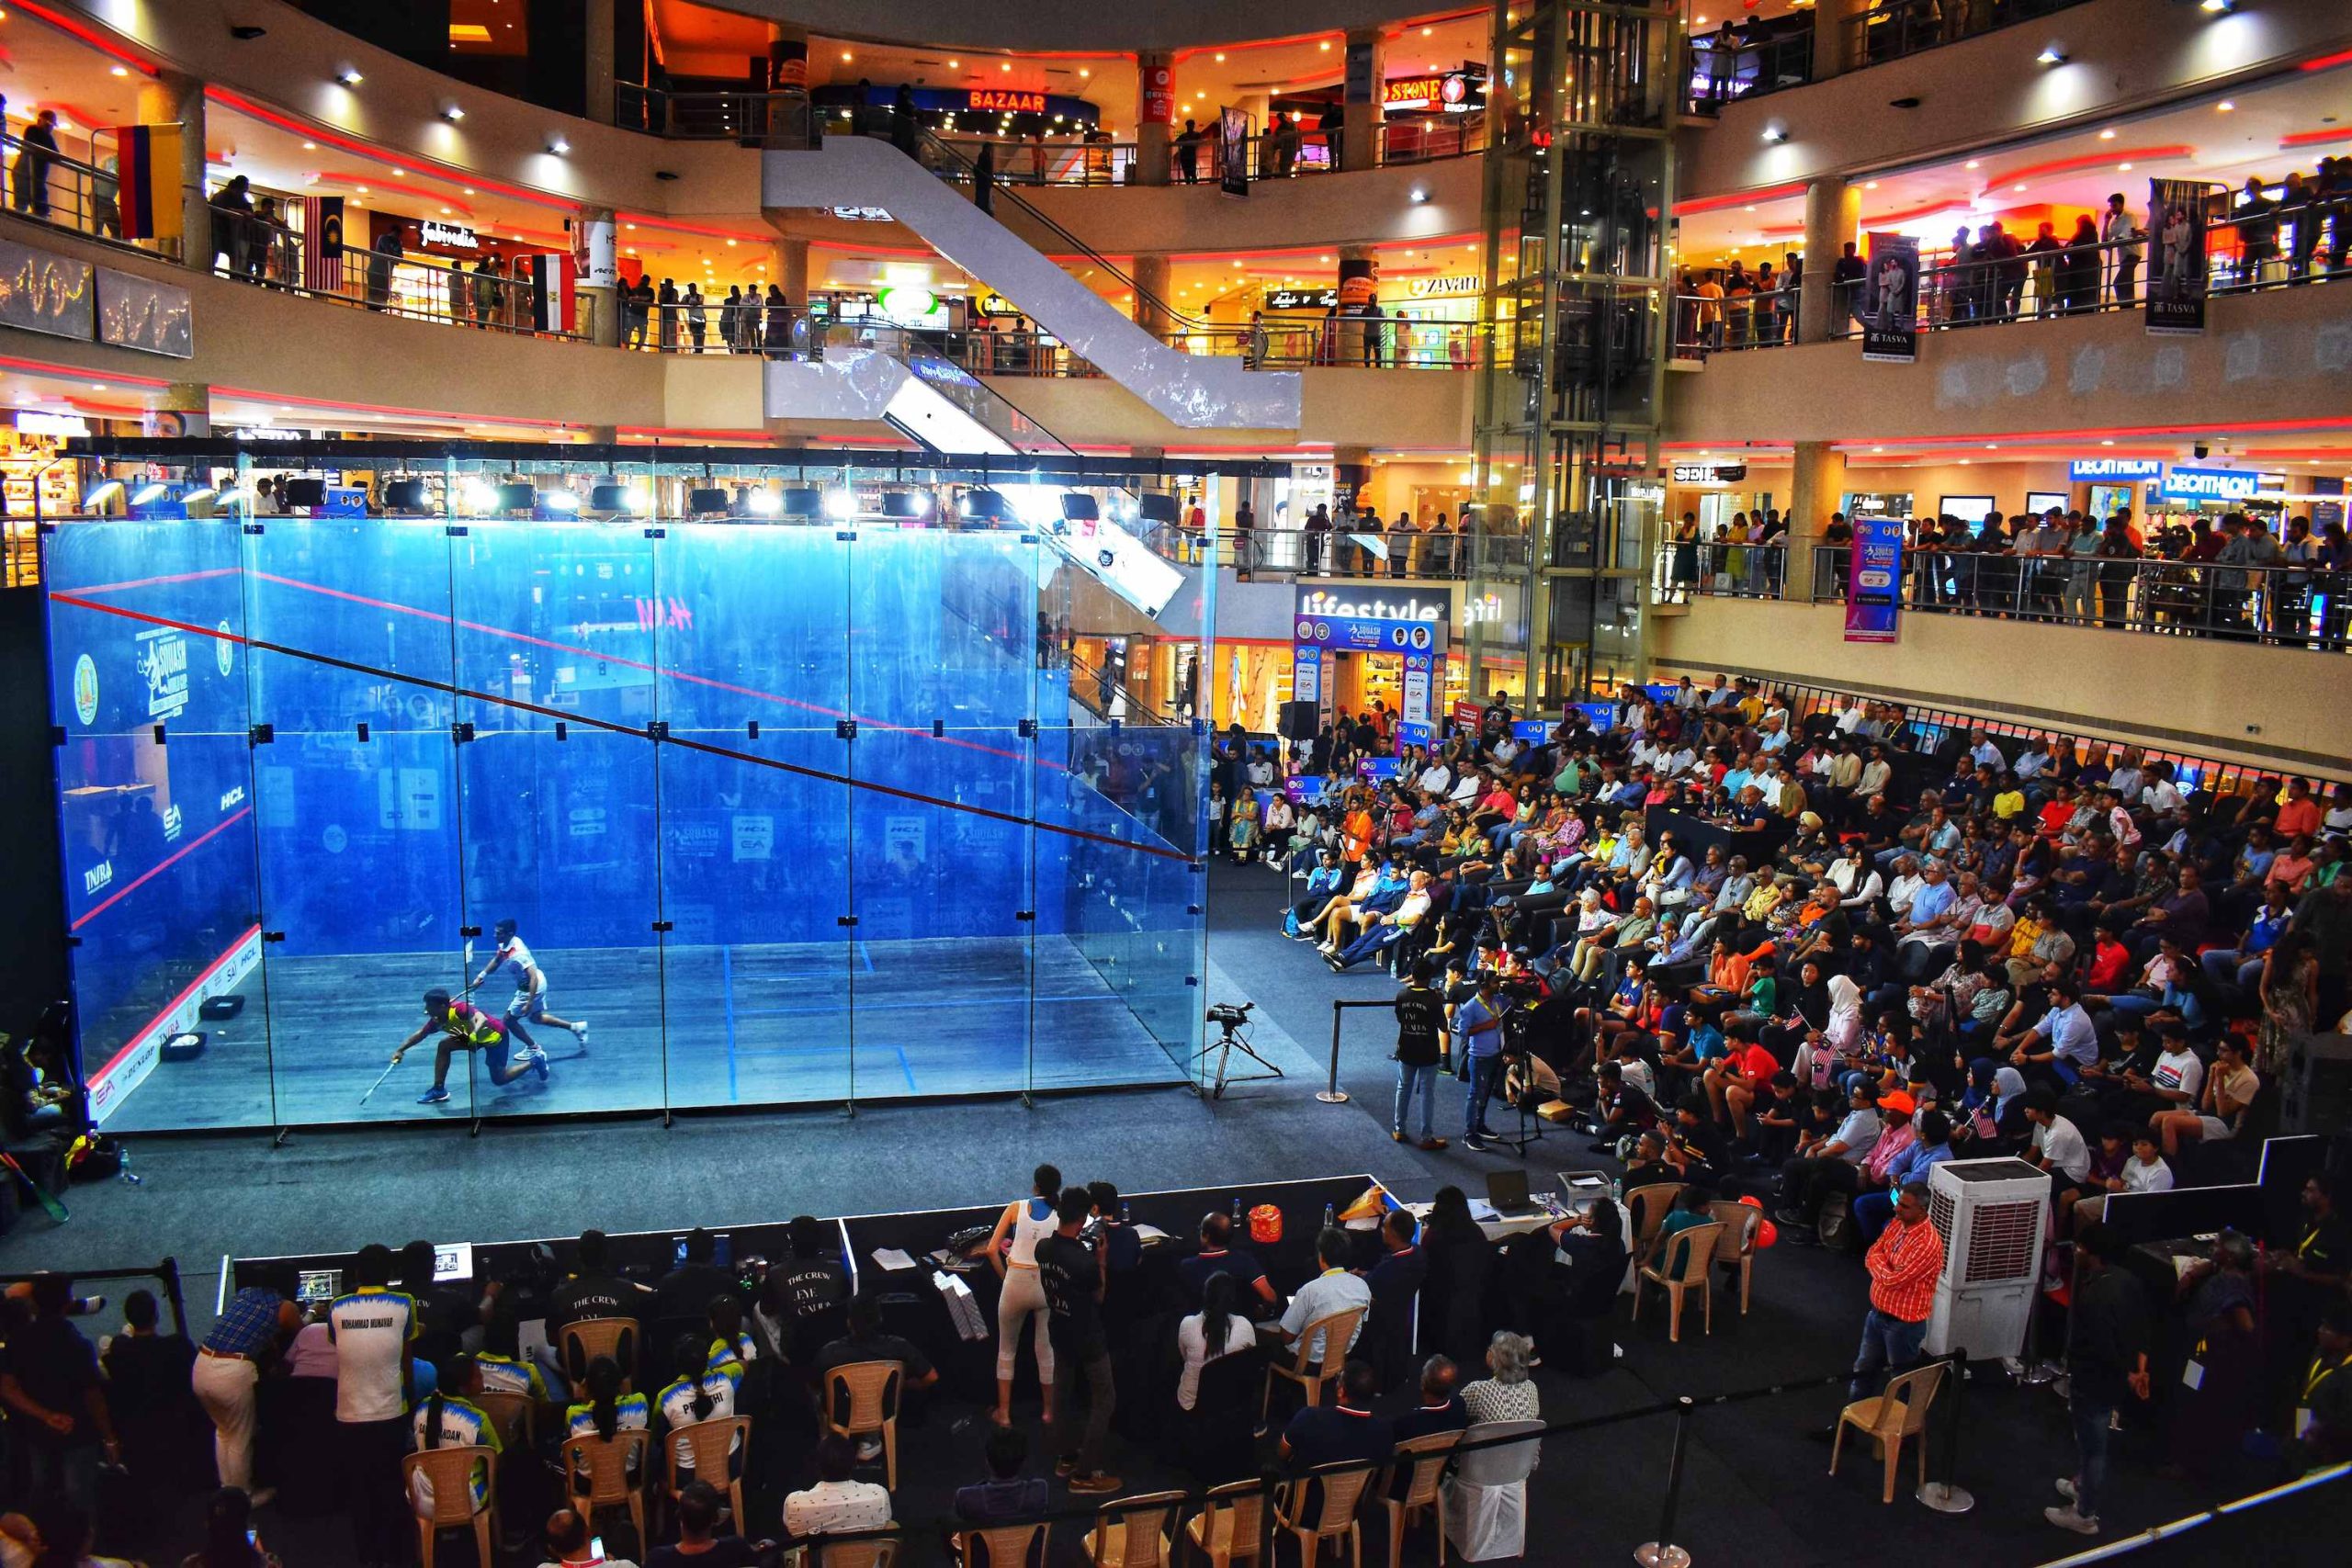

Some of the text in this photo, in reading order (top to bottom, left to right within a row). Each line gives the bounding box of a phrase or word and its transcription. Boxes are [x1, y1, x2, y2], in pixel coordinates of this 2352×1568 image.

[1391, 80, 1441, 101] STONE
[970, 92, 1045, 111] BAZAAR
[2167, 303, 2195, 313] TASVA
[1882, 334, 1907, 344] TASVA
[1674, 467, 1718, 481] SEI
[2074, 460, 2158, 474] DECATHLON
[2165, 473, 2255, 494] DECATHLON
[1303, 592, 1439, 621] lifestyle
[159, 639, 187, 677] SQUASH
[220, 786, 245, 811] HCL
[164, 804, 182, 829] EA
[241, 947, 256, 966] HCL
[127, 1045, 155, 1079] DUNLOP
[96, 1078, 116, 1106] EA
[788, 1271, 831, 1286] THE CREW
[416, 1300, 431, 1308] EW
[573, 1295, 618, 1309] THE CREW
[341, 1319, 369, 1330] MOHAMMAD
